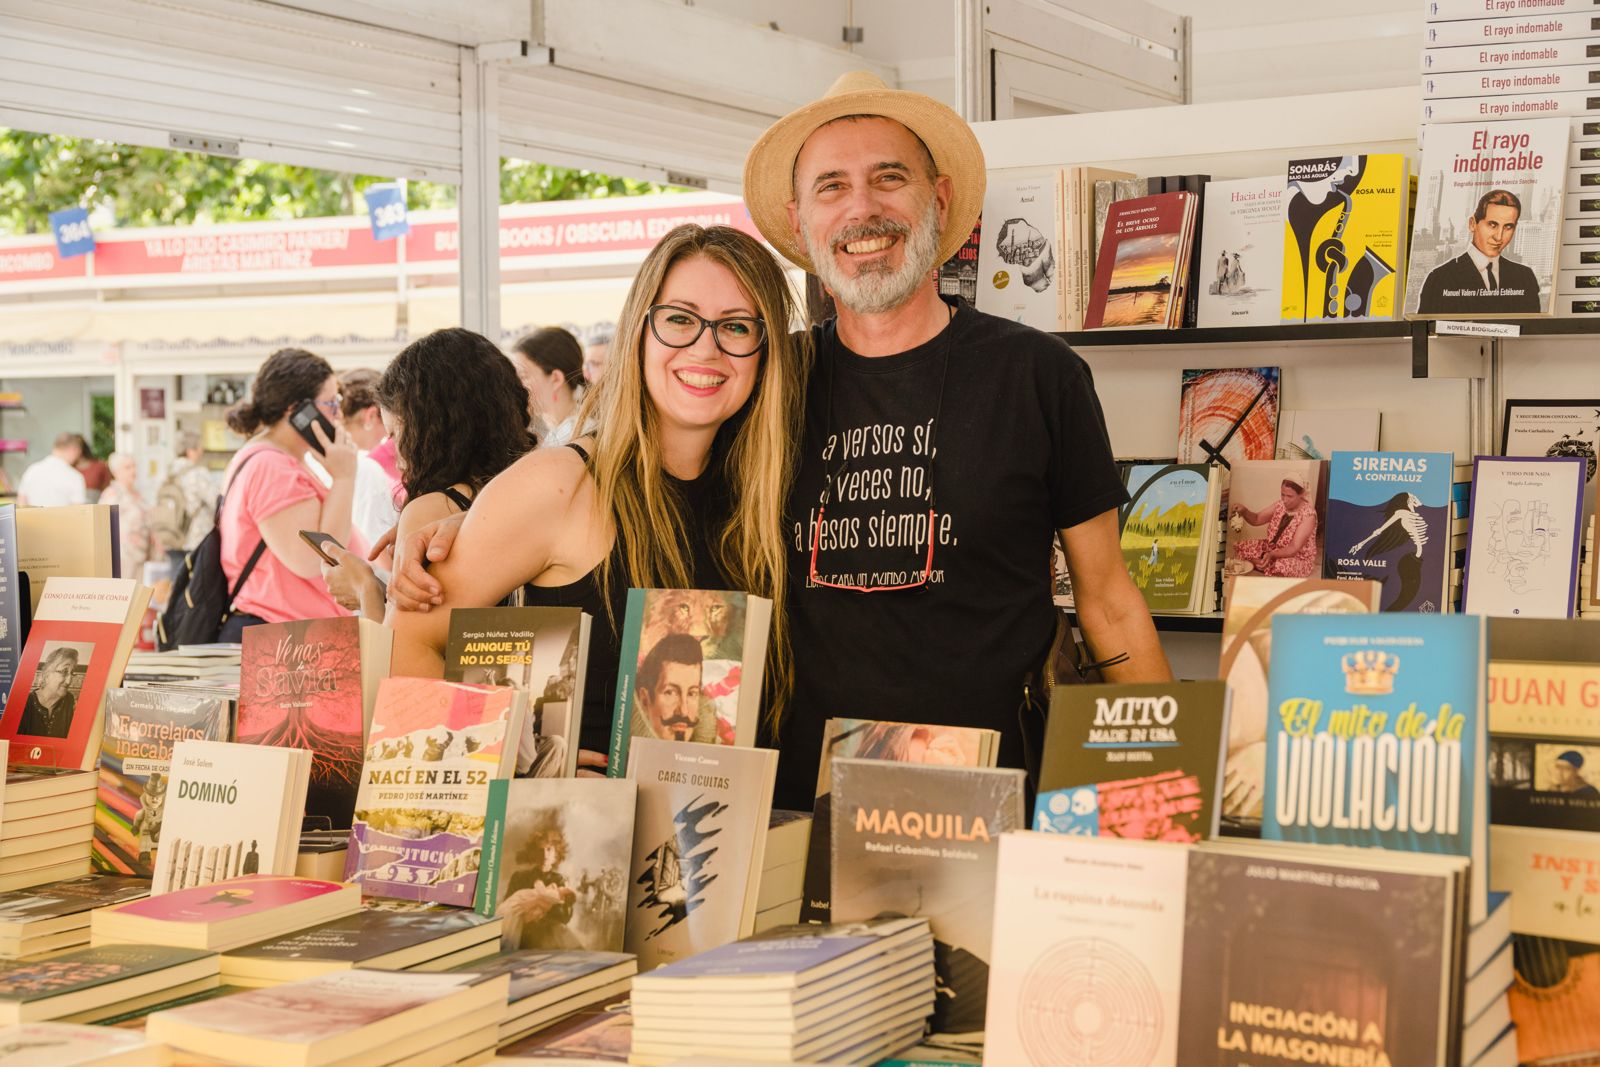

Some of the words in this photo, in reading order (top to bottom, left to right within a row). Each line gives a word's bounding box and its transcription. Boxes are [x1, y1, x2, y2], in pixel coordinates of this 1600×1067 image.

[1485, 0, 1494, 10] El
[1496, 0, 1515, 10] rayo
[1484, 25, 1492, 36] El
[1495, 26, 1514, 38] rayo
[1516, 20, 1563, 34] indomable
[1480, 52, 1488, 63] El
[1490, 53, 1509, 64] rayo
[1512, 48, 1558, 61] indomable
[1482, 78, 1490, 88] El
[1492, 78, 1511, 90] rayo
[1514, 73, 1560, 87] indomable
[1480, 103, 1489, 114] El
[1490, 104, 1510, 116] rayo
[1512, 99, 1558, 112] indomable
[1472, 130, 1488, 150] El
[1493, 132, 1530, 154] rayo
[1289, 161, 1337, 174] SONARÁS
[1453, 153, 1544, 174] indomable
[1232, 191, 1256, 202] Hacia
[1258, 189, 1266, 199] el
[1268, 190, 1282, 198] sur
[1142, 216, 1160, 224] OCASO
[500, 225, 553, 249] BOOKS
[565, 218, 644, 245] OBSCURA
[958, 248, 978, 260] LEJOS
[1442, 288, 1460, 297] Manuel
[1480, 288, 1500, 296] Eduardo
[822, 434, 837, 460] a
[842, 424, 905, 460] versos
[912, 418, 936, 460] sí,
[1352, 457, 1428, 472] SIRENAS
[837, 468, 892, 502] veces
[900, 466, 932, 501] no,
[1365, 474, 1423, 482] CONTRALUZ
[794, 522, 803, 552] a
[808, 508, 860, 552] besos
[1337, 558, 1360, 566] ROSA
[1362, 559, 1387, 568] VALLE
[831, 574, 856, 586] PARA
[856, 574, 868, 586] UN
[870, 571, 907, 586] MUNDO
[463, 632, 485, 640] Sergio
[486, 630, 508, 638] Núñez
[510, 630, 534, 638] Vadillo
[276, 634, 323, 666] Venas
[464, 642, 513, 653] AUNQUE
[514, 640, 531, 652] TÚ
[460, 655, 478, 666] NO
[480, 655, 495, 666] LO
[496, 654, 533, 666] SEPAS
[256, 667, 338, 697] Savia
[1488, 677, 1567, 706] JUAN
[1093, 695, 1178, 726] MITO
[1279, 698, 1323, 740] El
[1328, 704, 1388, 741] mito
[1396, 703, 1427, 741] de
[1434, 703, 1466, 744] la
[1089, 728, 1128, 743] MADE
[1130, 728, 1148, 742] IN
[1149, 728, 1177, 742] USA
[184, 757, 196, 766] José
[368, 766, 412, 785] NACÍ
[414, 770, 438, 785] EN
[442, 770, 462, 785] EL
[466, 770, 488, 785] 52
[658, 770, 688, 784] CARAS
[690, 774, 730, 790] OCULTAS
[1276, 720, 1462, 835] VIOLACIÓN
[178, 780, 238, 805] DOMINÓ
[378, 792, 404, 800] PEDRO
[405, 792, 424, 800] JOSÉ
[425, 792, 468, 800] MARTÍNEZ
[856, 808, 990, 842] MAQUILA
[865, 842, 894, 852] Rafael
[1246, 865, 1277, 880] JULIO
[1230, 1002, 1358, 1040] INICIACIÓN
[1362, 1022, 1383, 1044] A
[1217, 1028, 1248, 1052] LA
[1250, 1032, 1393, 1067] MASONERÍA
